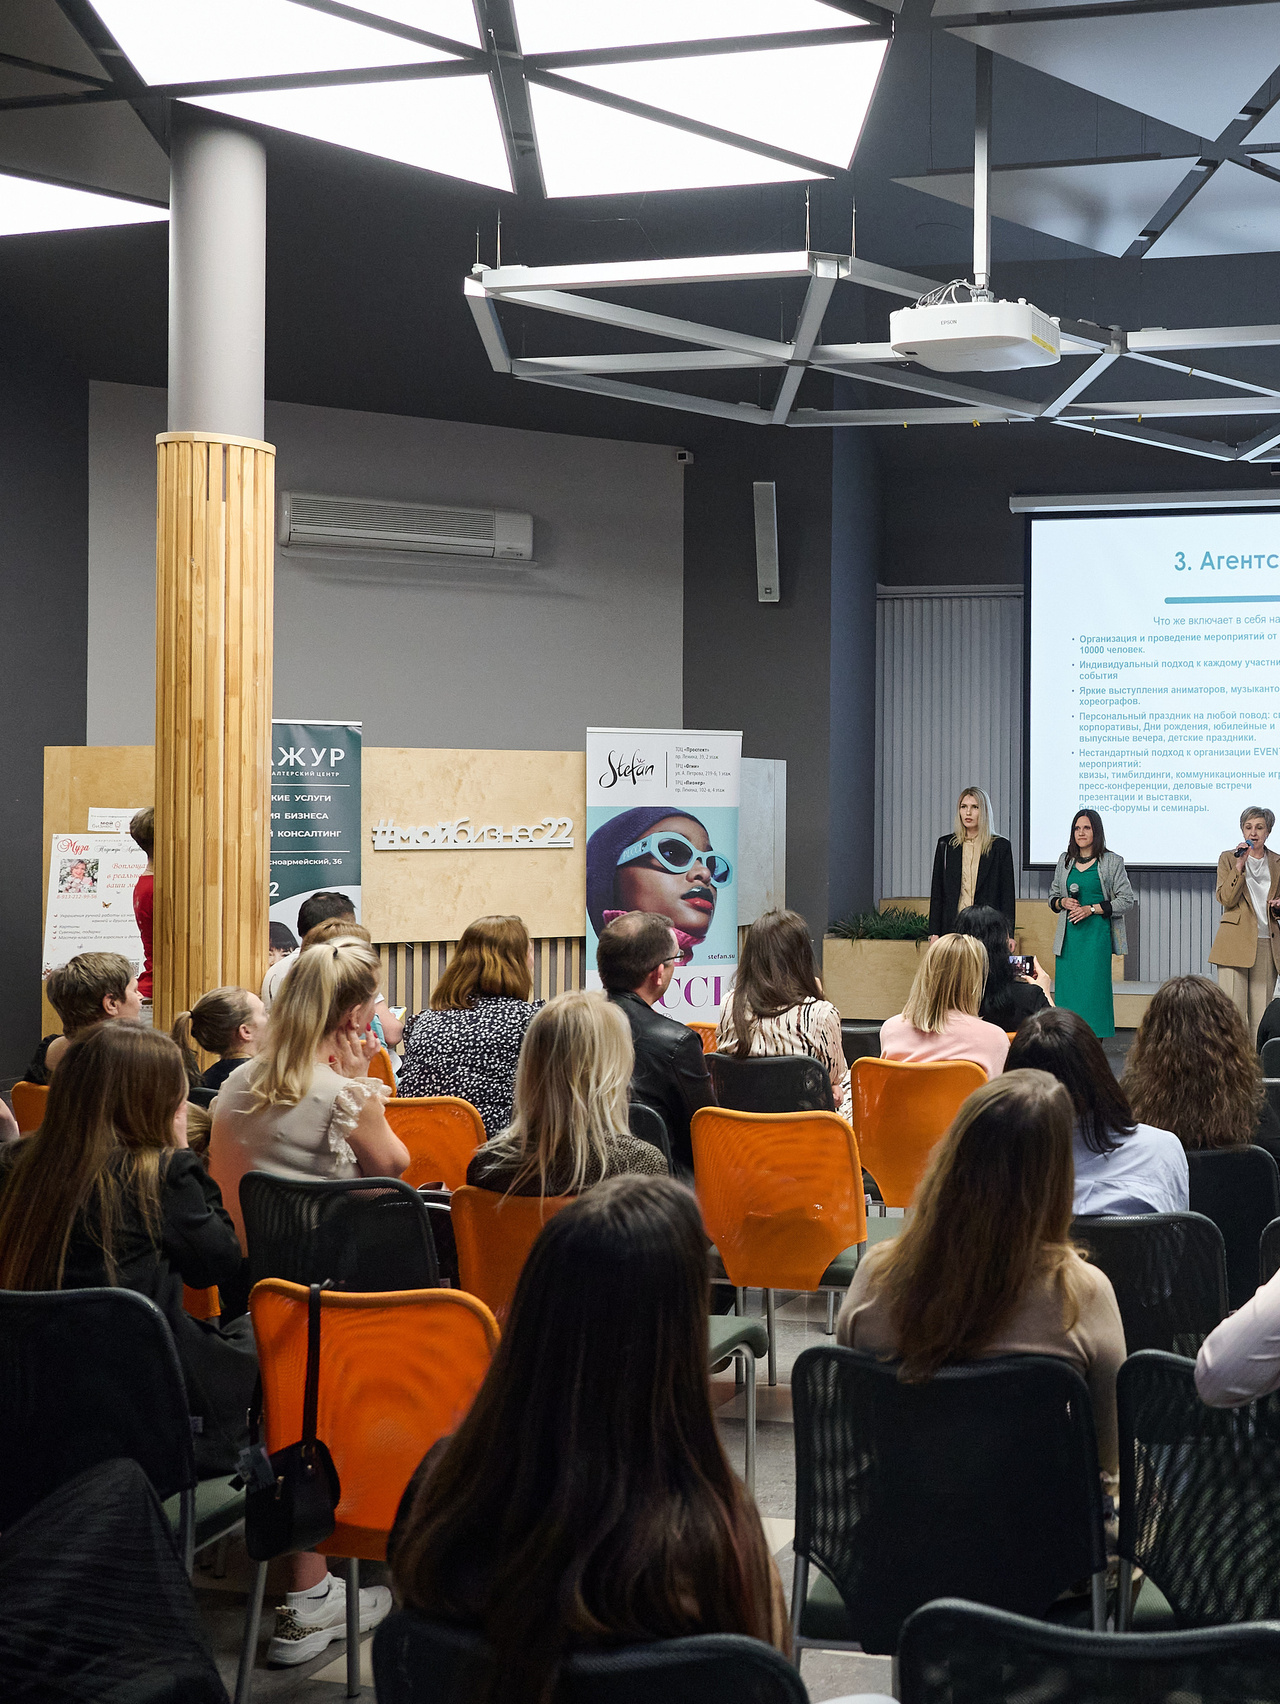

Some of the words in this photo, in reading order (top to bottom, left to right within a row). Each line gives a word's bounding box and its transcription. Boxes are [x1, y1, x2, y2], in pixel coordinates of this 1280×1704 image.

[1174, 551, 1192, 571] 3.
[1153, 616, 1171, 626] Что
[1173, 617, 1186, 625] же
[1188, 616, 1233, 625] включает
[1244, 614, 1266, 624] себя
[1079, 634, 1137, 645] Организация
[1147, 635, 1202, 643] проведение
[1203, 631, 1265, 642] мероприятий
[1079, 646, 1105, 654] 10000
[1106, 646, 1145, 654] человек.
[1079, 660, 1159, 670] Индивидуальный
[1161, 660, 1194, 668] подход
[1203, 660, 1243, 668] каждому
[1079, 671, 1118, 680] события
[1079, 686, 1106, 696] Яркие
[1108, 686, 1169, 696] выступления
[1170, 686, 1228, 695] аниматоров,
[1079, 696, 1141, 707] хореографов.
[1079, 712, 1147, 722] Персональный
[1148, 712, 1191, 722] праздник
[1193, 712, 1204, 720] на
[1206, 711, 1237, 720] любой
[1239, 712, 1270, 721] повод:
[1079, 724, 1141, 733] корпоративы,
[1143, 722, 1161, 732] Дни
[1163, 723, 1211, 732] рождения,
[1213, 722, 1267, 731] юбилейные
[1079, 735, 1130, 744] выпускные
[1132, 735, 1166, 743] вечера,
[1167, 734, 1204, 742] детские
[1205, 734, 1257, 743] праздники.
[271, 747, 345, 767] ЖУР
[1079, 748, 1149, 758] Нестандартный
[1151, 749, 1184, 758] подход
[1193, 749, 1251, 758] организации
[598, 749, 654, 788] Stefan
[1079, 760, 1141, 769] мероприятий:
[1078, 771, 1109, 779] квизы,
[1111, 770, 1174, 779] тимбилдинги,
[1175, 771, 1266, 780] коммуникационные
[1078, 782, 1171, 791] пресс-конференции,
[1172, 782, 1214, 791] деловые
[1215, 782, 1252, 791] встречи
[294, 794, 332, 802] УСЛУГИ
[1078, 794, 1136, 802] презентации
[1145, 794, 1192, 802] выставки,
[1160, 804, 1210, 813] семинары.
[284, 812, 329, 820] БИЗНЕСА
[277, 829, 342, 838] КОНСАЛТИНГ
[372, 816, 574, 851] #мойбизнес22
[57, 838, 90, 855] Муза
